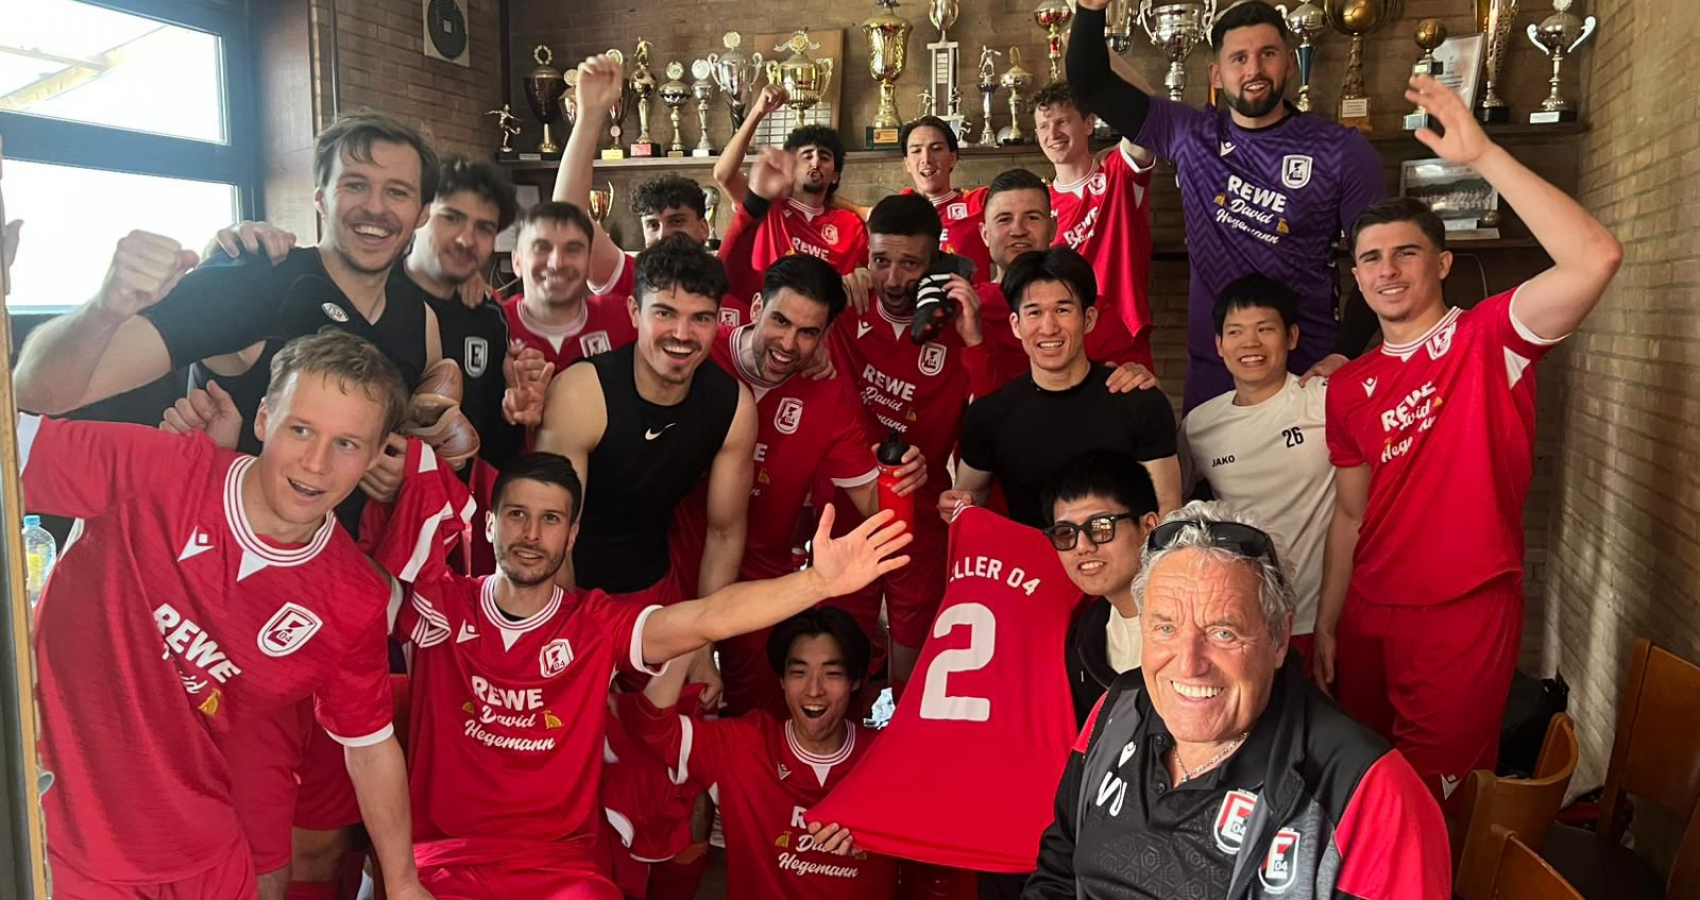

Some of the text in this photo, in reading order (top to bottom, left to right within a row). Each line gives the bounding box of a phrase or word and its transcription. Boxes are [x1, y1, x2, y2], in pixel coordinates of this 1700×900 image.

[1227, 174, 1287, 213] REWE
[1229, 199, 1274, 224] David
[792, 236, 829, 261] REWE
[862, 363, 916, 402] REWE
[866, 386, 903, 411] David
[1282, 426, 1304, 448] 26
[1212, 455, 1235, 467] JAKO
[950, 556, 1041, 596] LLER 04
[153, 602, 242, 684] REWE
[277, 630, 293, 643] 04
[553, 660, 566, 670] 04
[919, 602, 996, 722] 2
[471, 675, 544, 712] REWE
[480, 705, 536, 728] David
[464, 719, 556, 751] Hegemann
[778, 852, 859, 878] Hegemann
[1274, 860, 1289, 873] 04
